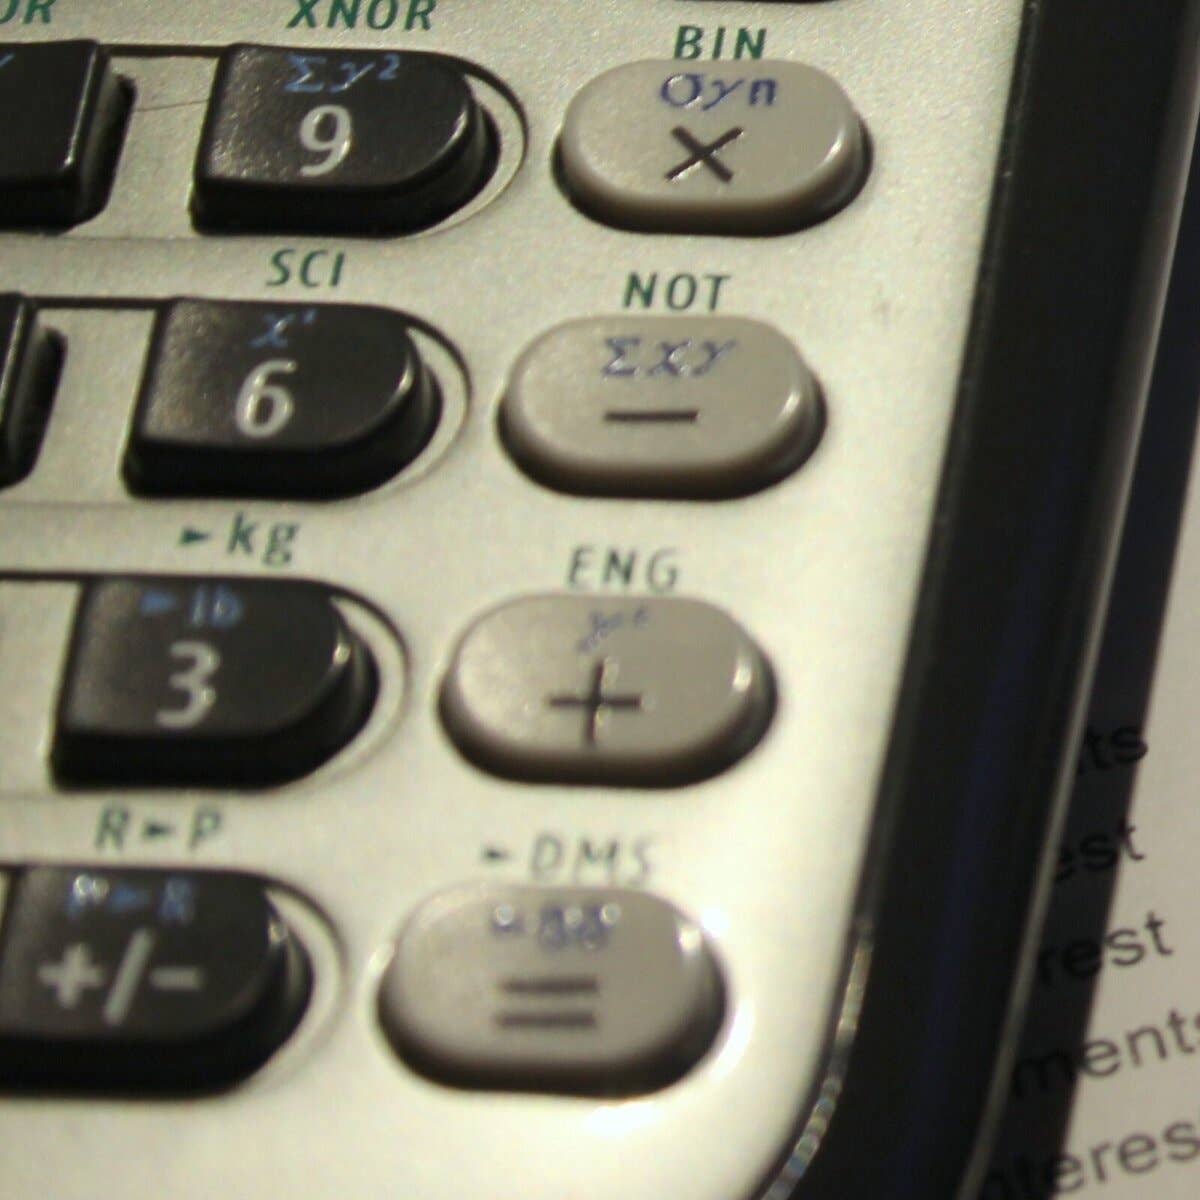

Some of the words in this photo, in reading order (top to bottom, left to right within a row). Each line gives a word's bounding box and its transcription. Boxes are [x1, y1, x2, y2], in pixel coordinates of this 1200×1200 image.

[672, 24, 768, 61] BIN
[299, 104, 353, 177] 9
[266, 248, 347, 287] SCI
[622, 271, 730, 311] NOT
[235, 358, 297, 438] 6
[566, 544, 681, 592] ENG
[154, 639, 221, 729] 3
